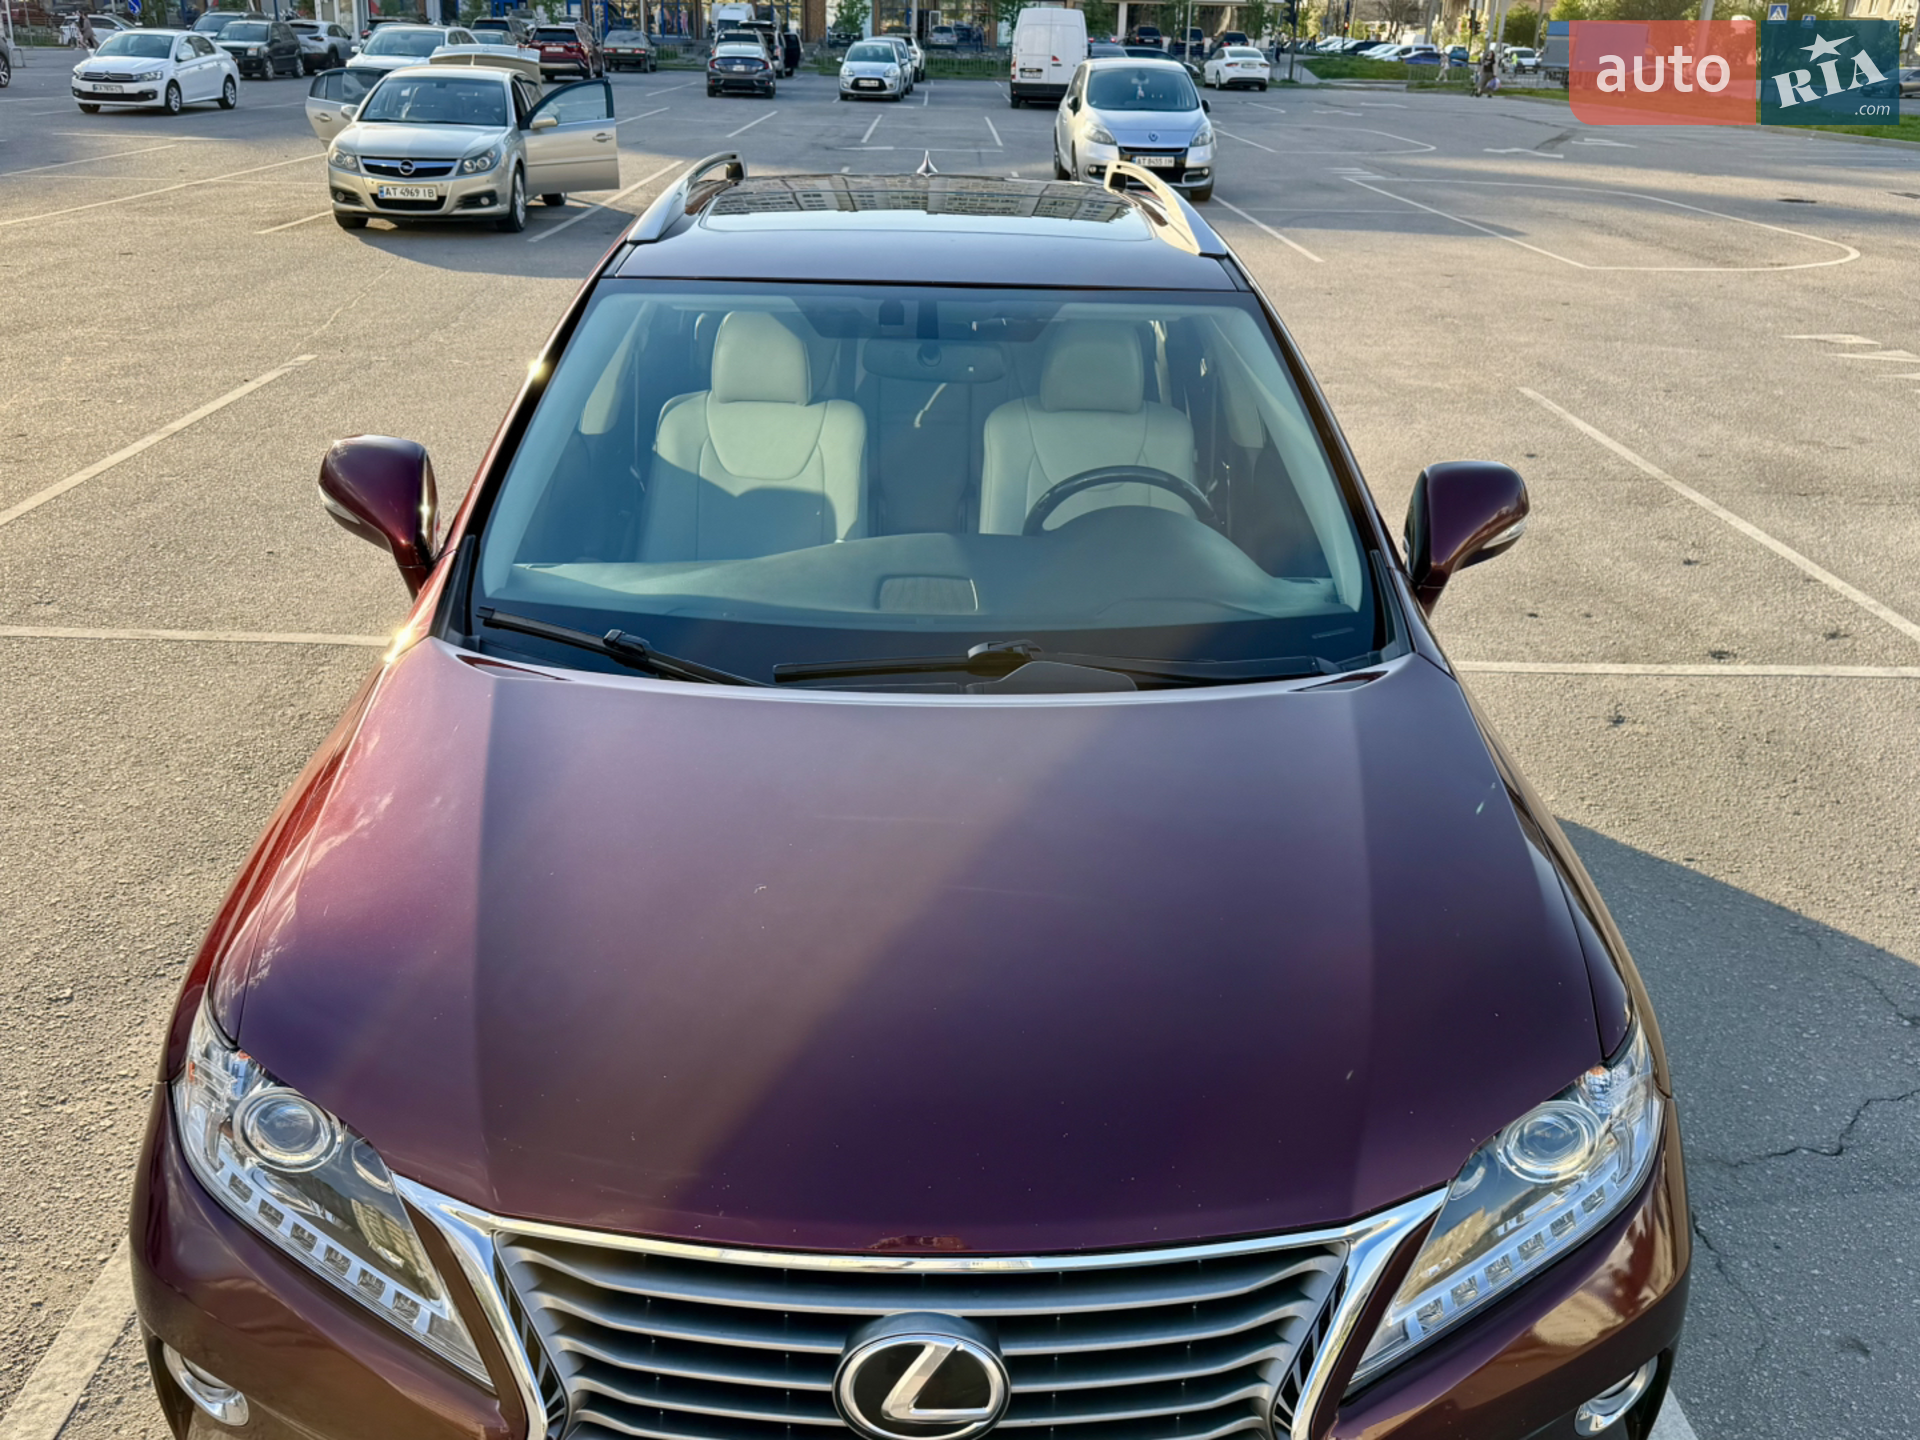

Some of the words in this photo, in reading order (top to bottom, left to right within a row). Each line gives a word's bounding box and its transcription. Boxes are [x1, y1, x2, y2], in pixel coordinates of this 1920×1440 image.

[385, 187, 398, 196] AT
[399, 187, 421, 197] 4969
[423, 188, 435, 198] IB
